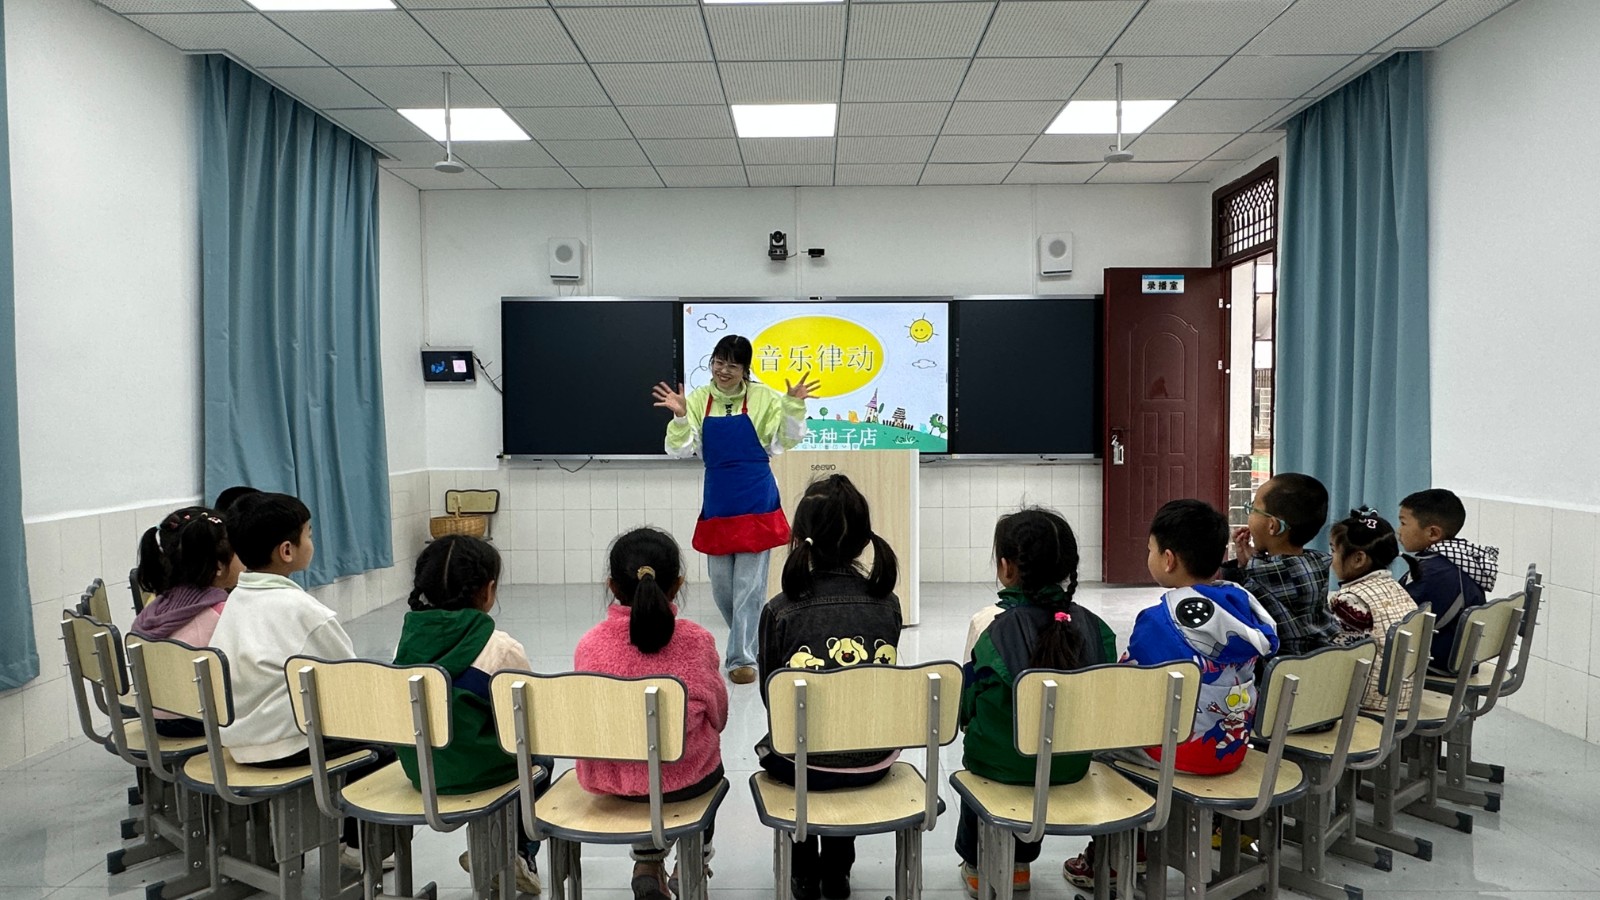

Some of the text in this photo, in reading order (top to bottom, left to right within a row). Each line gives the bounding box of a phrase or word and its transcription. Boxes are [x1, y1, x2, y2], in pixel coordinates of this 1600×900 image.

[1147, 281, 1178, 290] 录播室
[757, 344, 873, 372] 音乐律动
